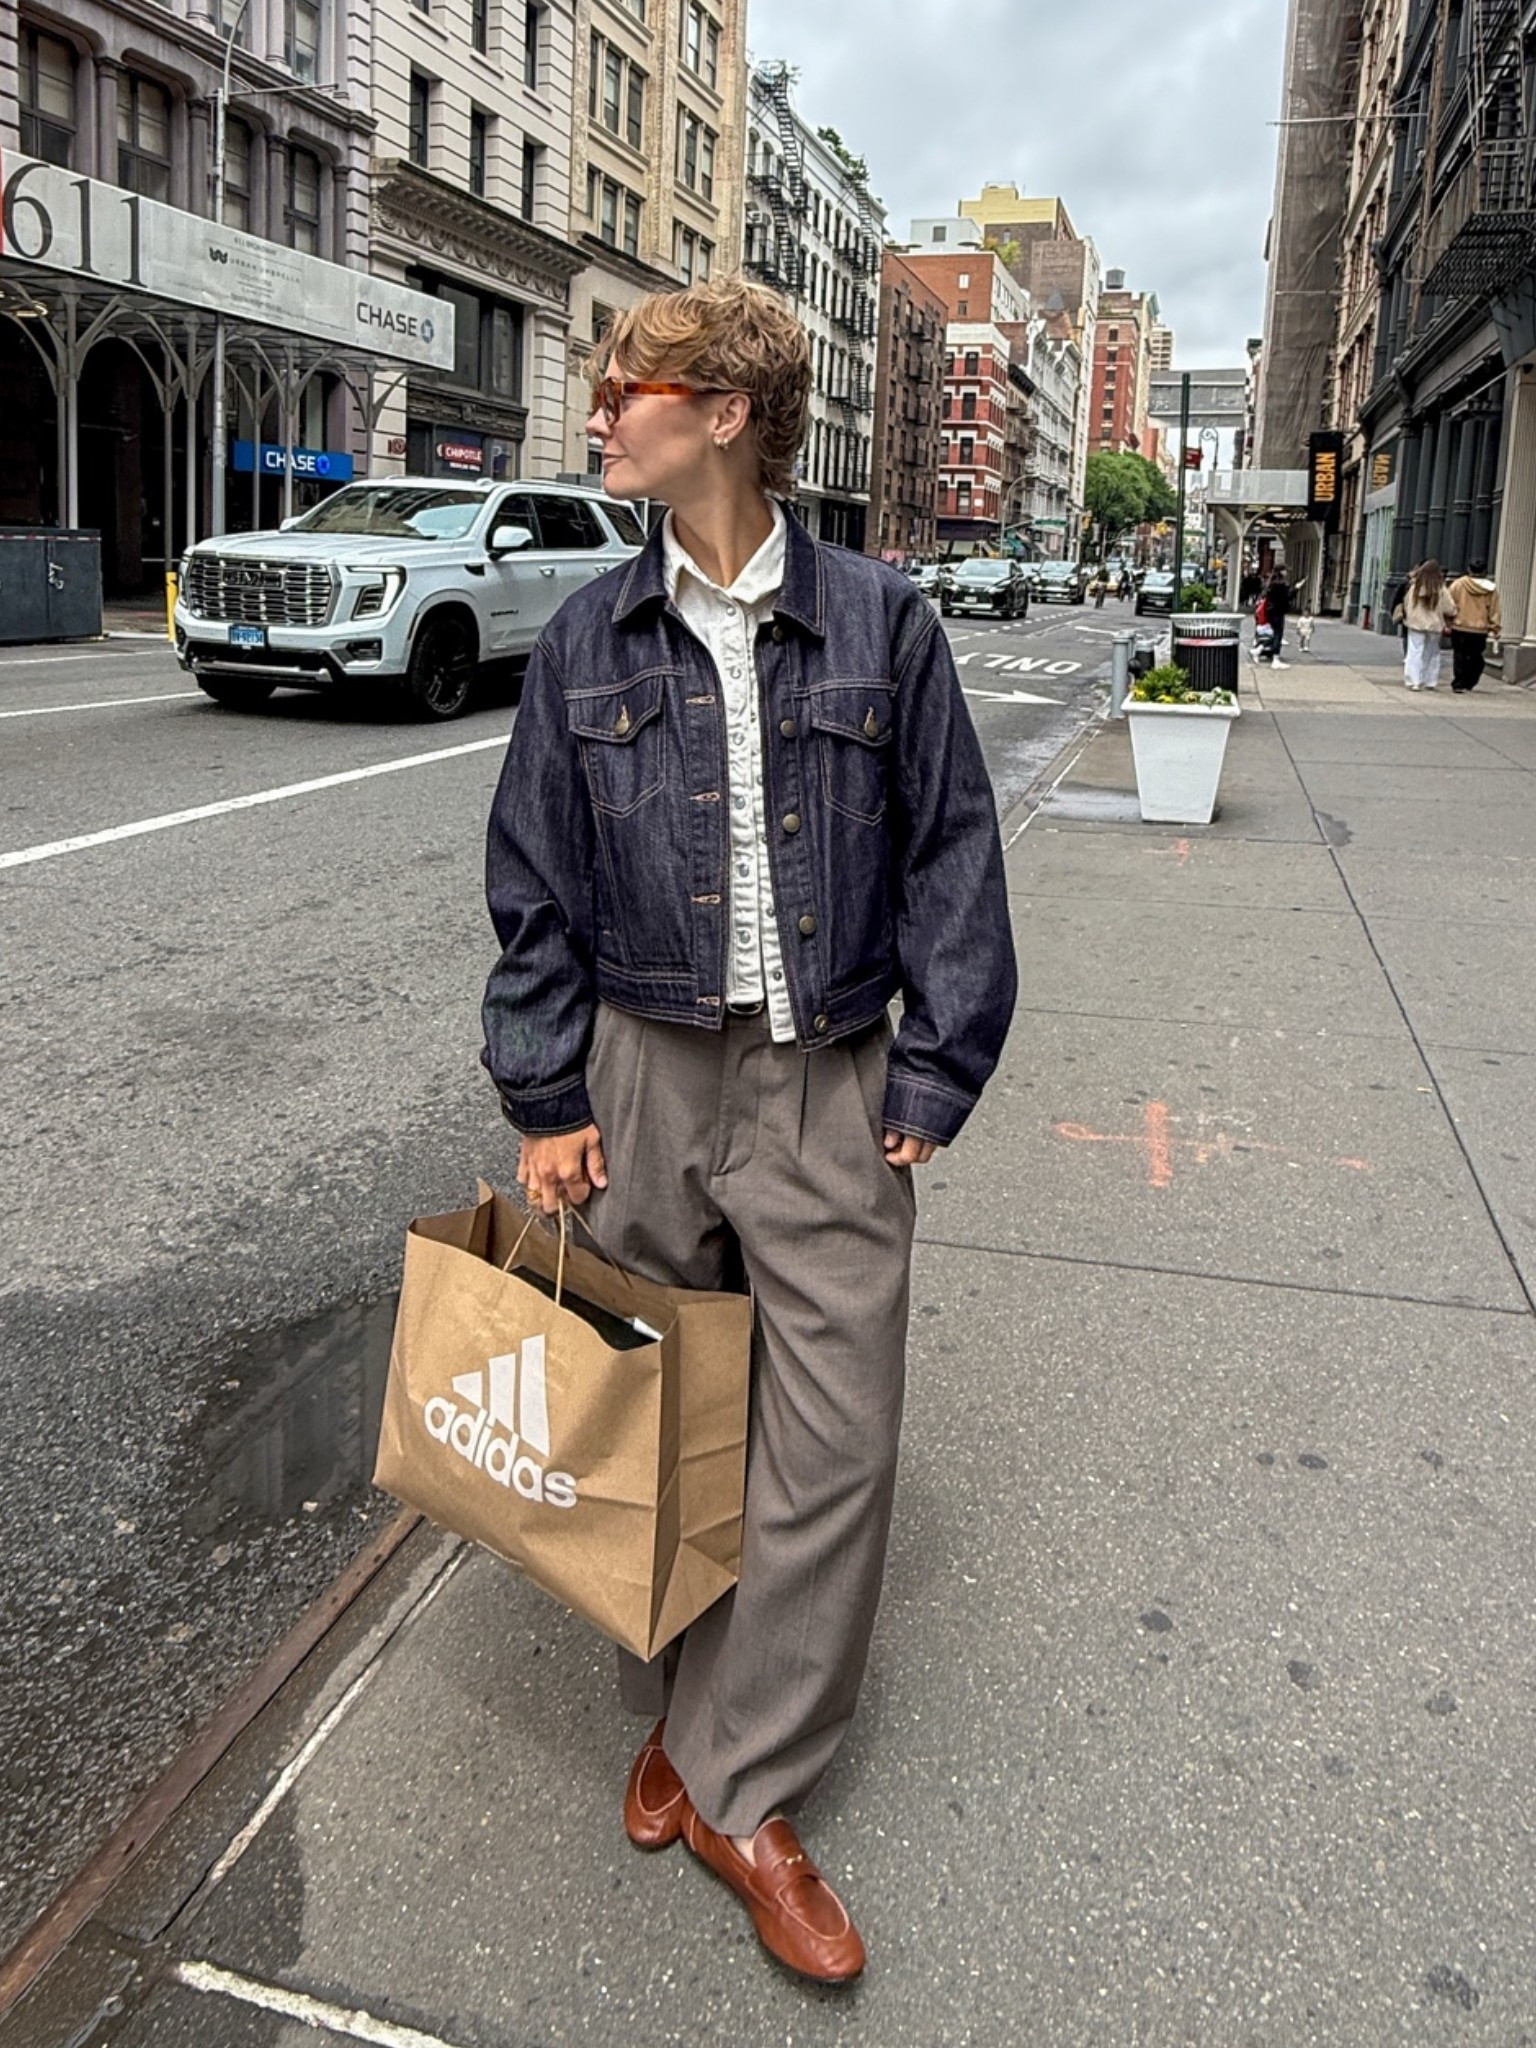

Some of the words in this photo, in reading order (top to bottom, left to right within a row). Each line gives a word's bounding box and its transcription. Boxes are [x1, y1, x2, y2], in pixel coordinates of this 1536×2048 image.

[2, 162, 148, 288] 611
[356, 301, 418, 338] CHASE
[1314, 451, 1337, 502] URBAN
[424, 1396, 578, 1508] adidas
